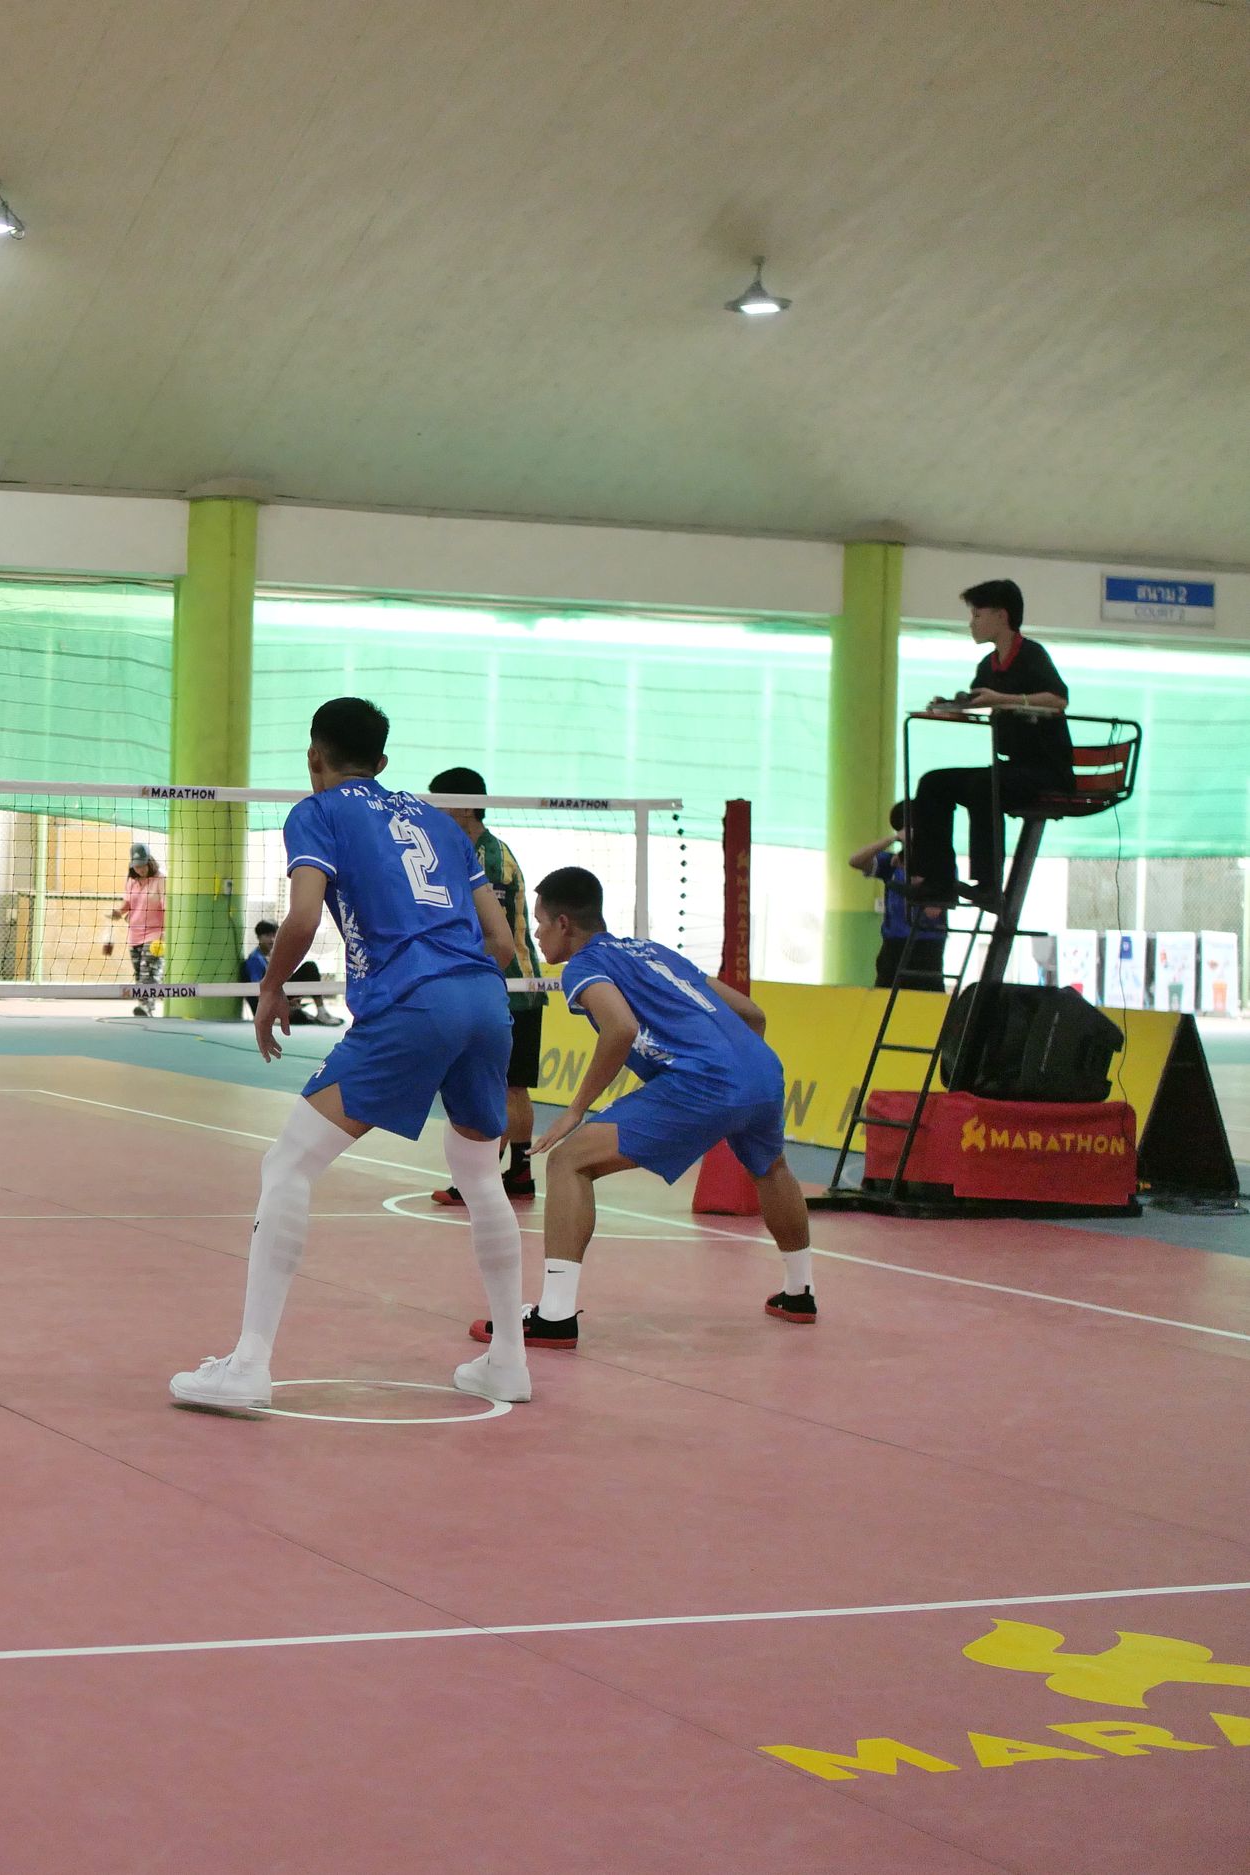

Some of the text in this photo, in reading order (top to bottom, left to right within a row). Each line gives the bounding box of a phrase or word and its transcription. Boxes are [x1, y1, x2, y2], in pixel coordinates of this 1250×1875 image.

[151, 787, 215, 799] MARATHON
[549, 799, 608, 809] MARATHON
[388, 816, 453, 908] 2
[132, 987, 196, 998] MARATHON
[990, 1128, 1125, 1156] MARATHON
